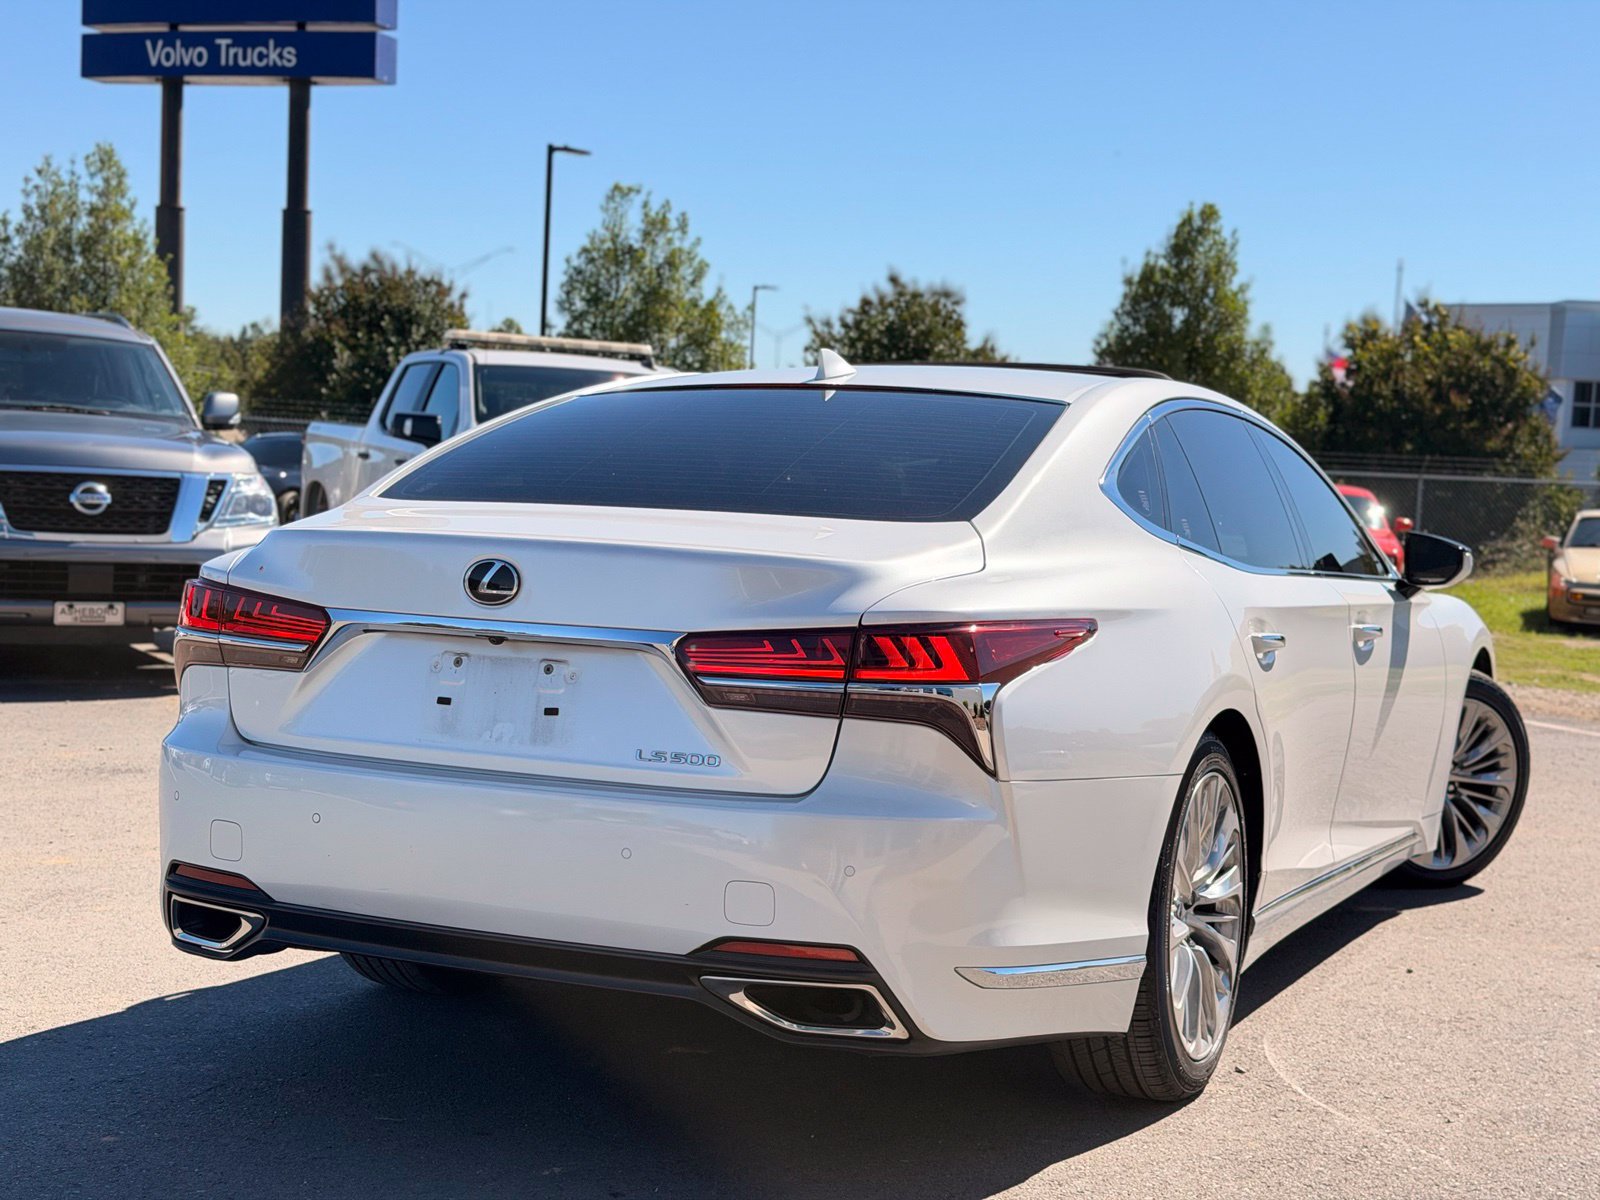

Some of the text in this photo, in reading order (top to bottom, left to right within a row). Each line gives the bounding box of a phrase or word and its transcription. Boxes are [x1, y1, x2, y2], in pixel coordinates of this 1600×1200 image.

[145, 38, 298, 68] Volvo Trucks
[60, 606, 119, 617] ASHEBORO
[635, 748, 721, 768] LS 500
